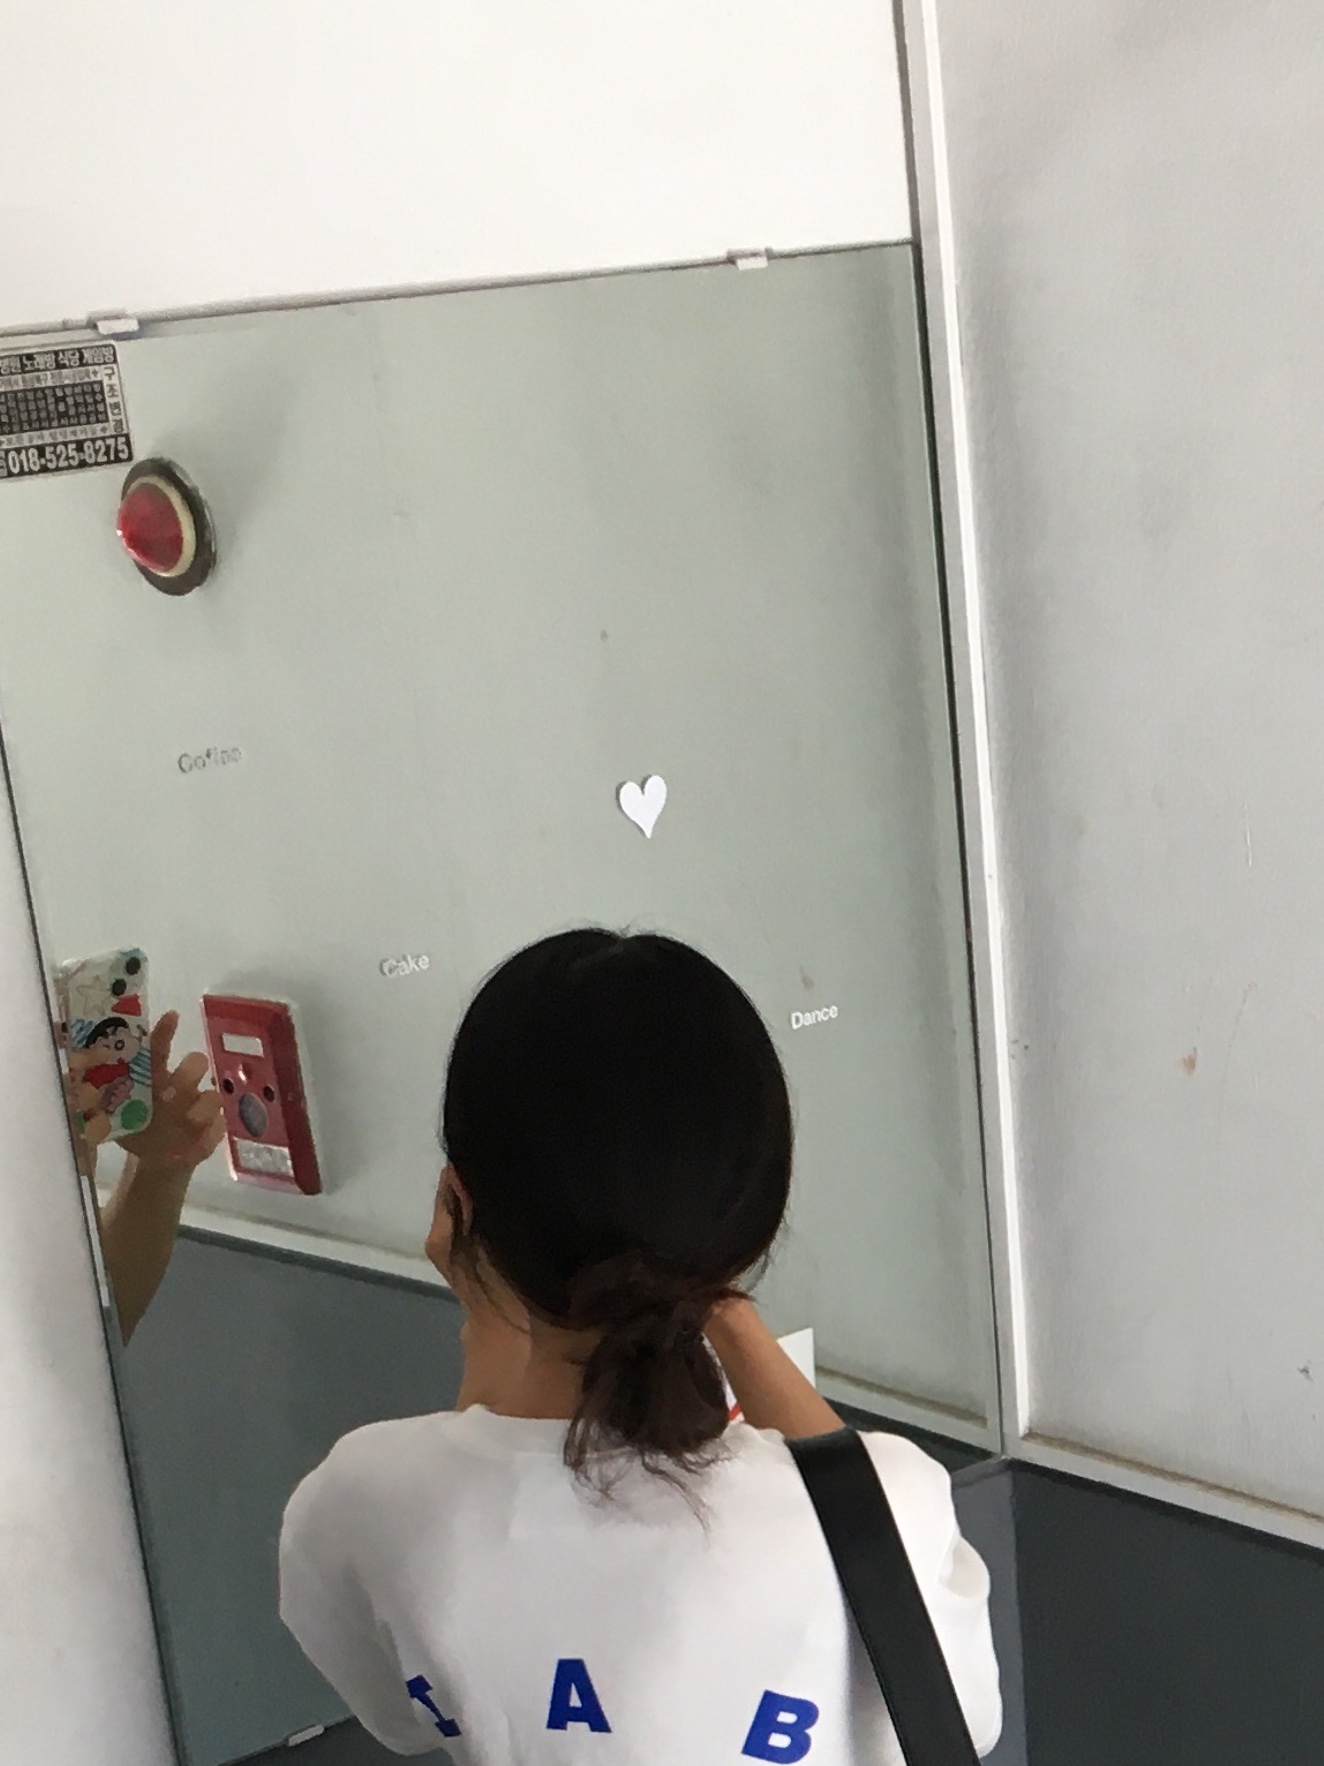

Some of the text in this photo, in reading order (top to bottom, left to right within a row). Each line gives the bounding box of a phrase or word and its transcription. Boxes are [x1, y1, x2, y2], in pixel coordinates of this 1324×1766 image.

[8, 436, 130, 474] 018-525-8275
[379, 954, 430, 978] Cake
[790, 1005, 838, 1030] Dance
